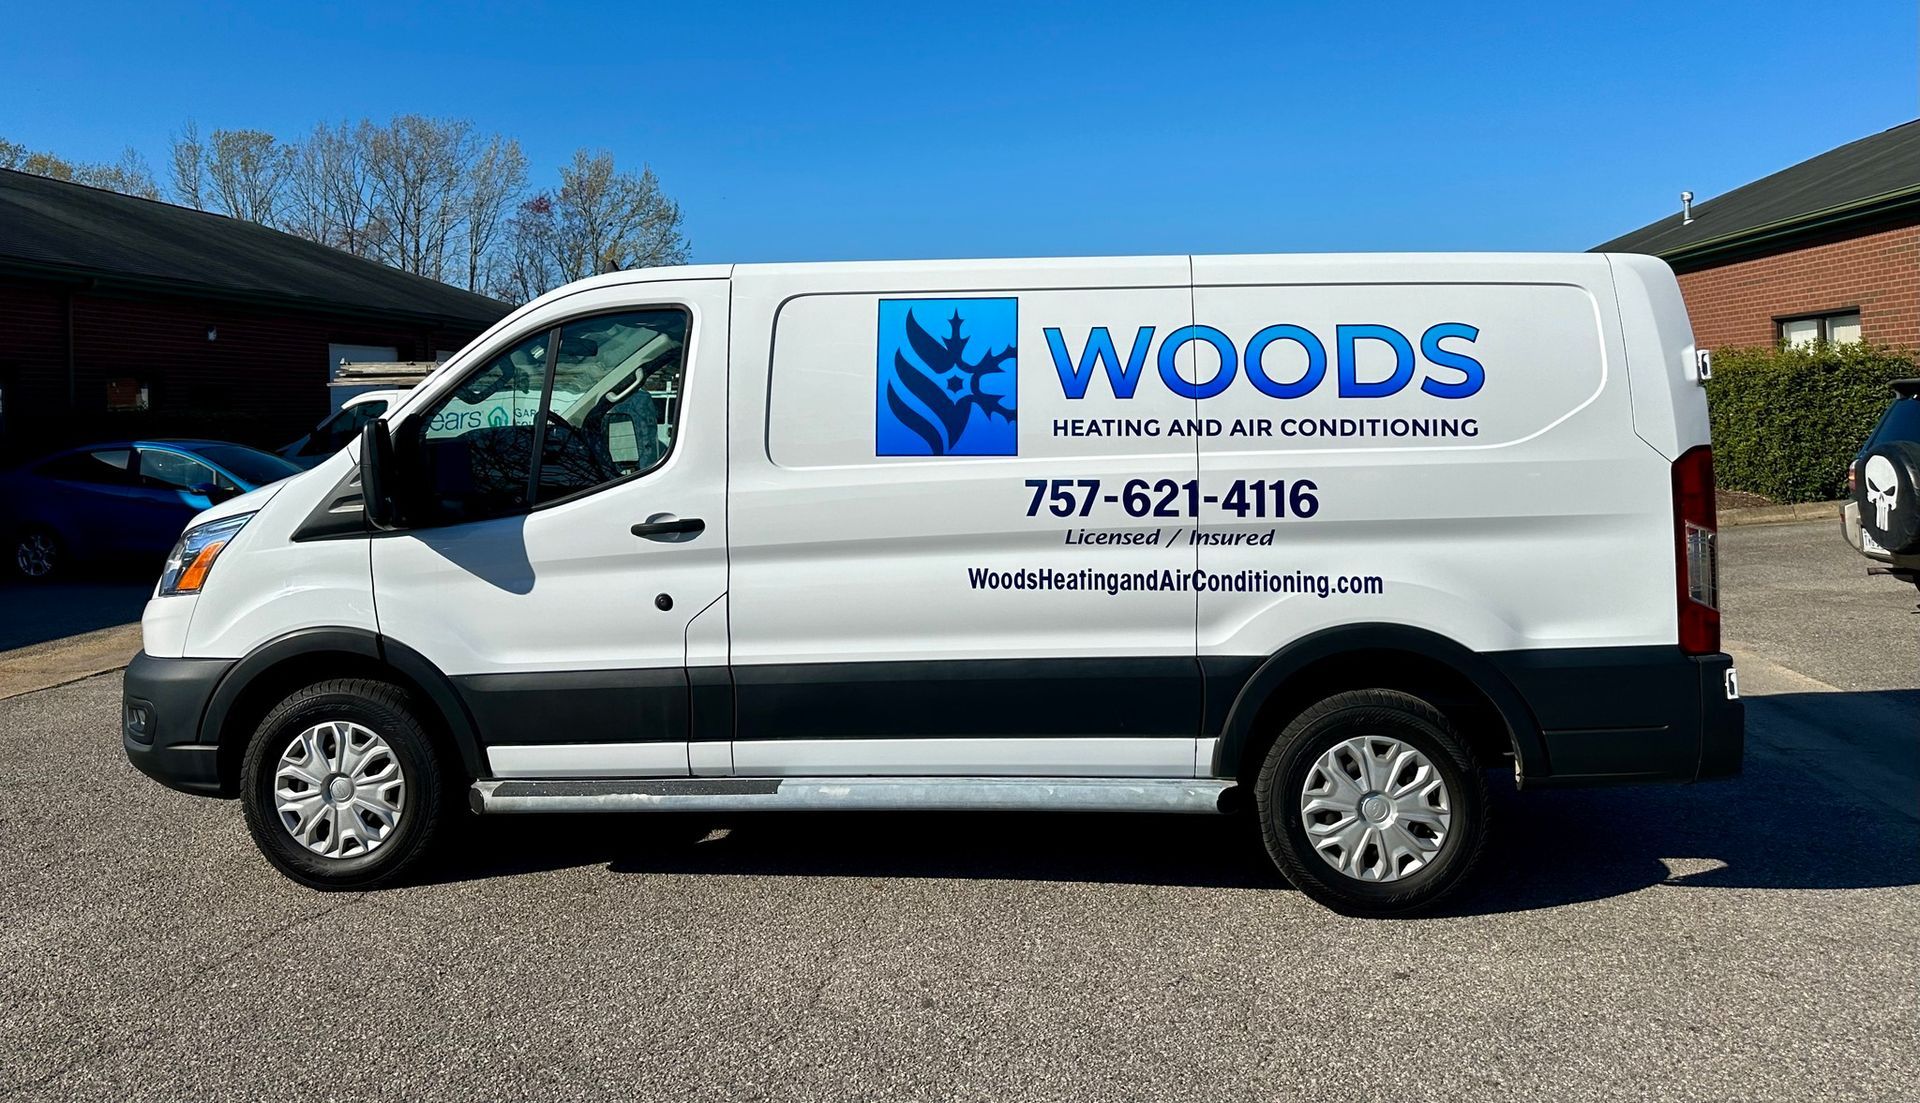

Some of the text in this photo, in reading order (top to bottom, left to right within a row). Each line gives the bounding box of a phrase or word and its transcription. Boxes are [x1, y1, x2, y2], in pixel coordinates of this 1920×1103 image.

[1043, 322, 1486, 400] WOODS
[430, 411, 482, 432] ears
[1053, 418, 1479, 437] HEATING AND AIR CONDITIONING
[1024, 478, 1319, 519] 757-621-4116
[1064, 528, 1162, 546] Licensed
[1188, 528, 1276, 546] Insured
[967, 567, 1383, 599] WoodsHeatingandAirConditioning.com
